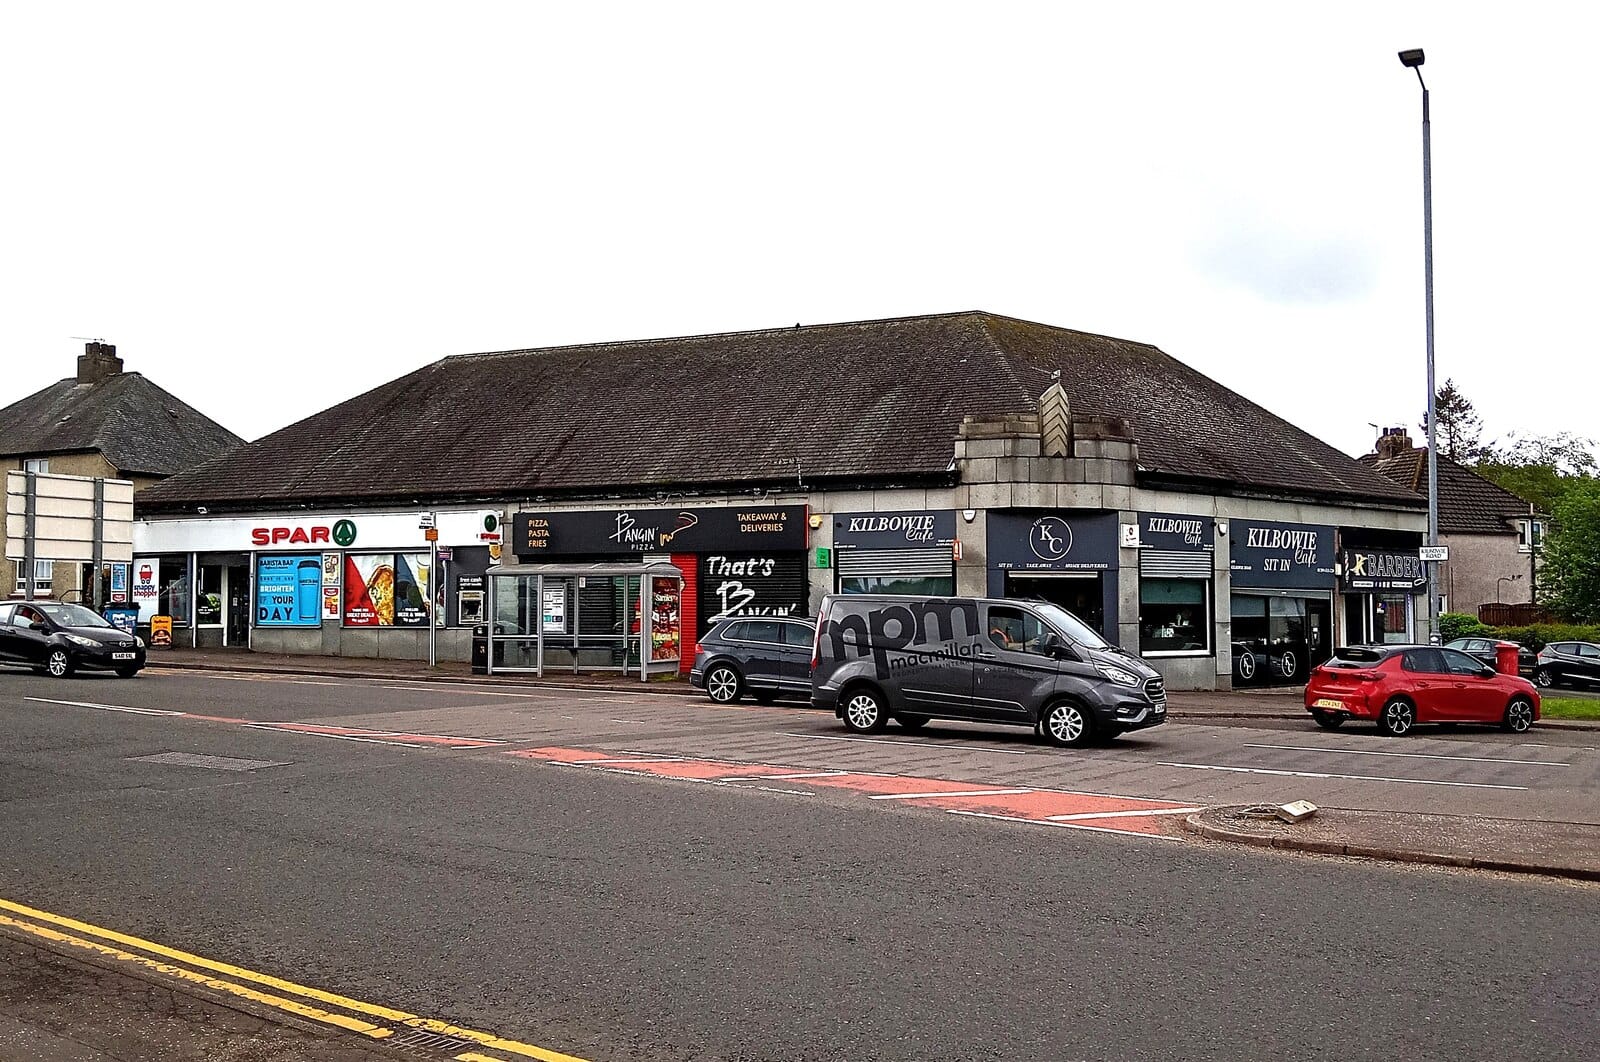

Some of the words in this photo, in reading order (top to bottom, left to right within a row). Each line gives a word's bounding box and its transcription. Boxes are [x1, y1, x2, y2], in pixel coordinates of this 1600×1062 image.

[528, 519, 549, 527] PIZZA
[737, 513, 779, 521] TAKEAWAY
[780, 513, 787, 521] &
[847, 515, 935, 532] KILBOWIE
[528, 529, 550, 537] PASTA
[740, 524, 784, 532] DELIVERIES
[1148, 518, 1203, 534] KILBOWIE
[251, 526, 330, 545] SPAR
[905, 528, 935, 543] Cafe
[1184, 532, 1203, 547] Cafe
[1246, 527, 1318, 551] KILBOWIE
[528, 540, 547, 548] FRIES
[631, 543, 655, 551] PIZZA
[1263, 558, 1279, 571] SIT
[1279, 559, 1291, 571] IN
[1294, 547, 1318, 568] Cafe
[706, 556, 775, 577] That's
[1367, 554, 1421, 578] BARBER
[134, 584, 155, 592] snappy
[134, 590, 157, 598] shopper
[272, 596, 294, 604] YOUR
[259, 607, 294, 621] DAY
[890, 642, 983, 670] macmillan
